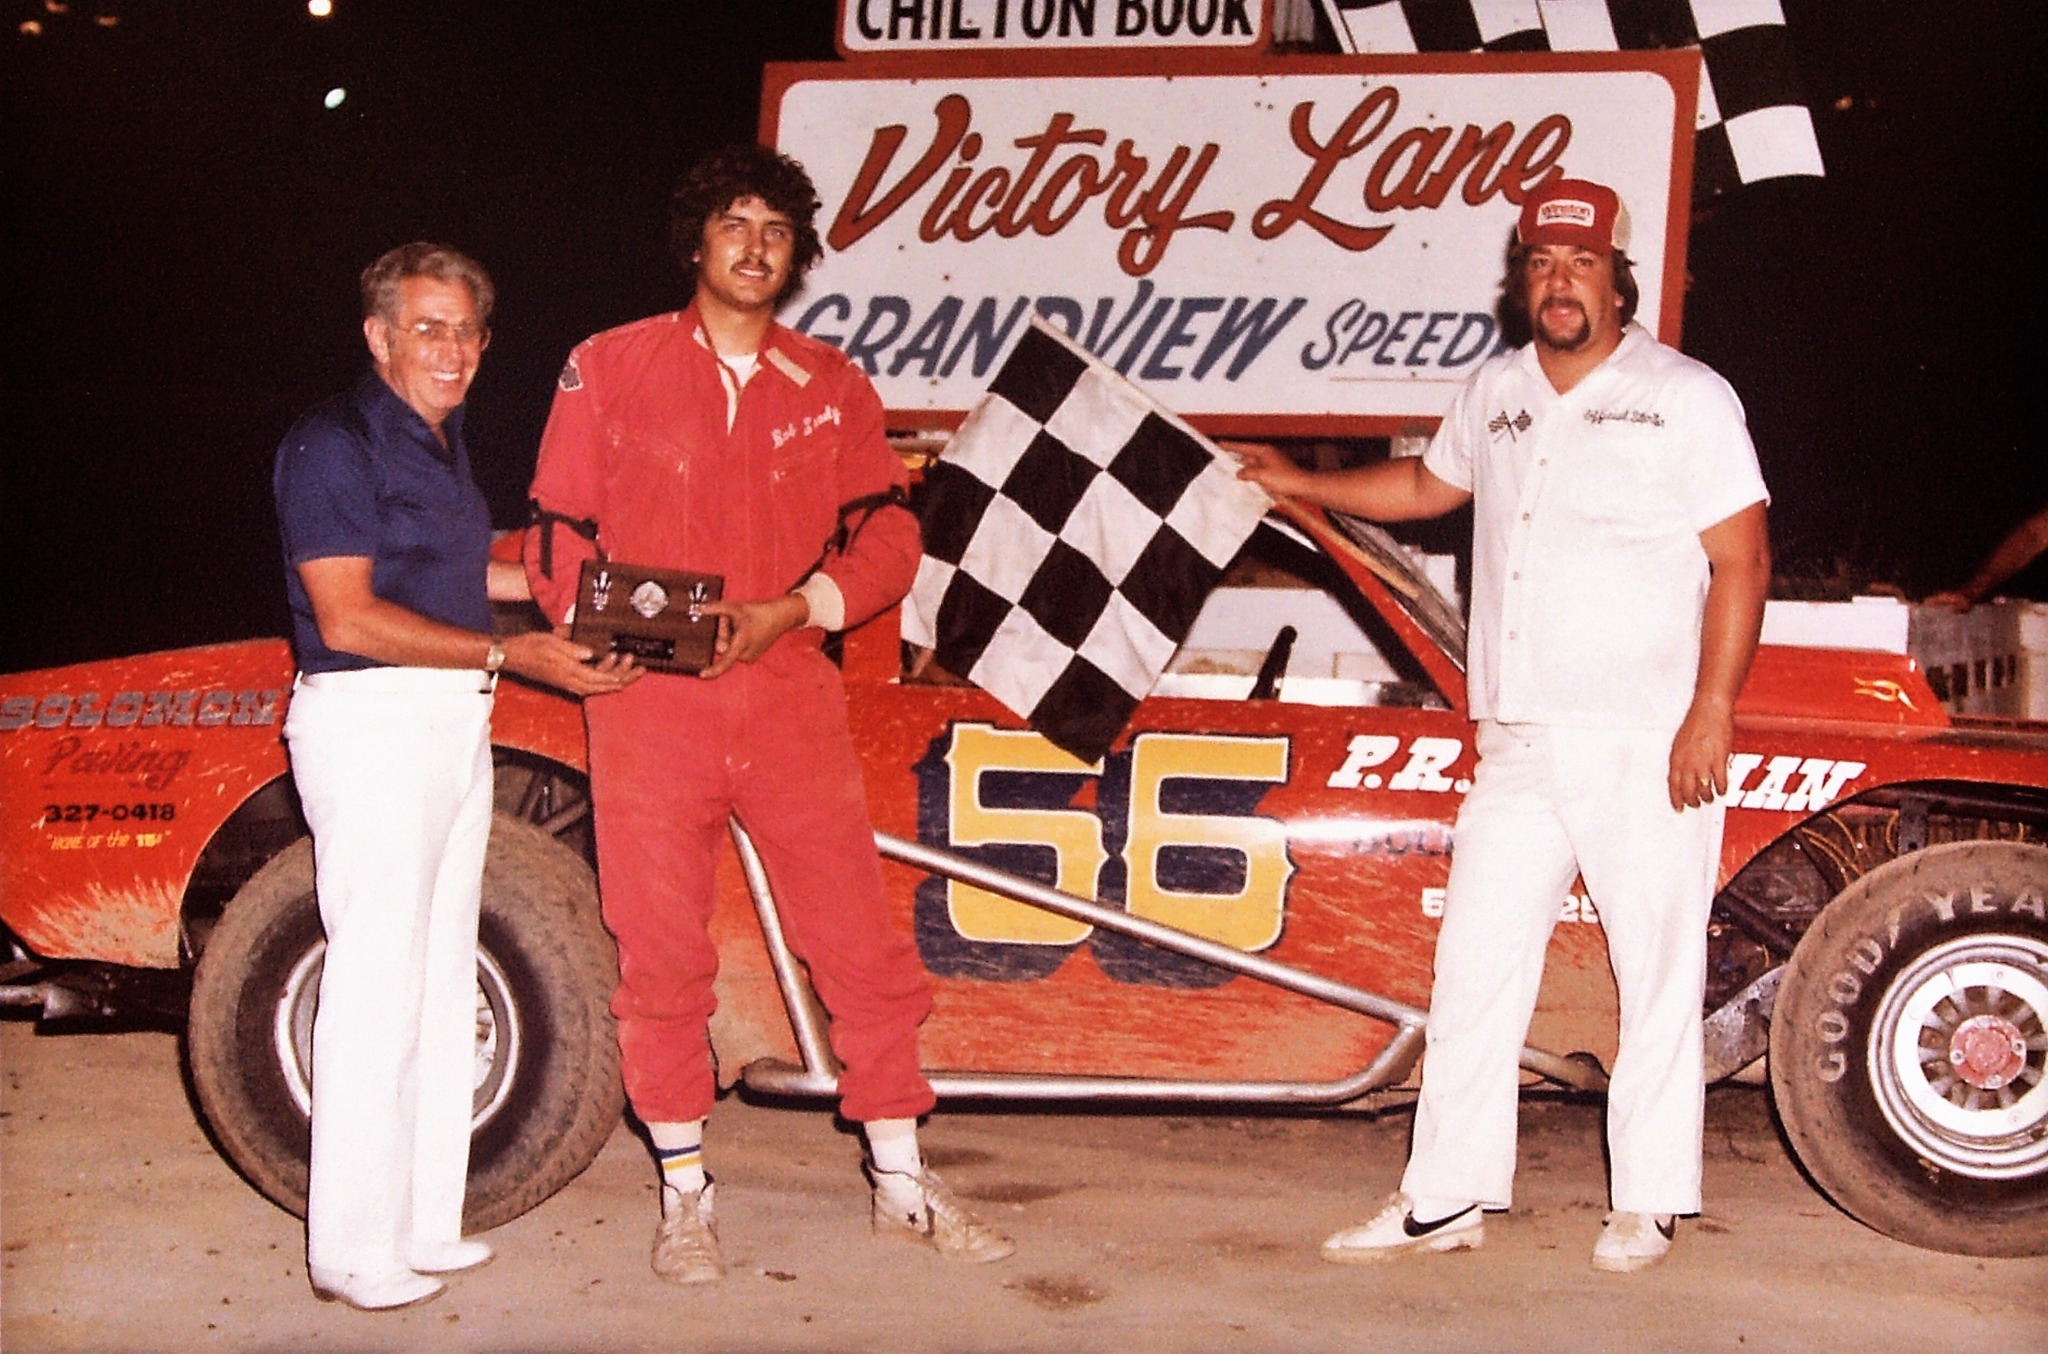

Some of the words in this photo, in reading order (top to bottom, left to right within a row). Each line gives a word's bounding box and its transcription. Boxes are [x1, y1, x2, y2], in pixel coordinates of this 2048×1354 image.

[856, 0, 1096, 39] CHILTON
[1115, 0, 1254, 37] BOOK
[827, 94, 1235, 277] Victory
[1252, 86, 1572, 251] Lane
[1300, 298, 1509, 371] SPEED
[0, 690, 280, 730] SOLOMON
[41, 736, 191, 791] Paving
[44, 803, 176, 823] 327-0418
[944, 722, 1296, 953] 56
